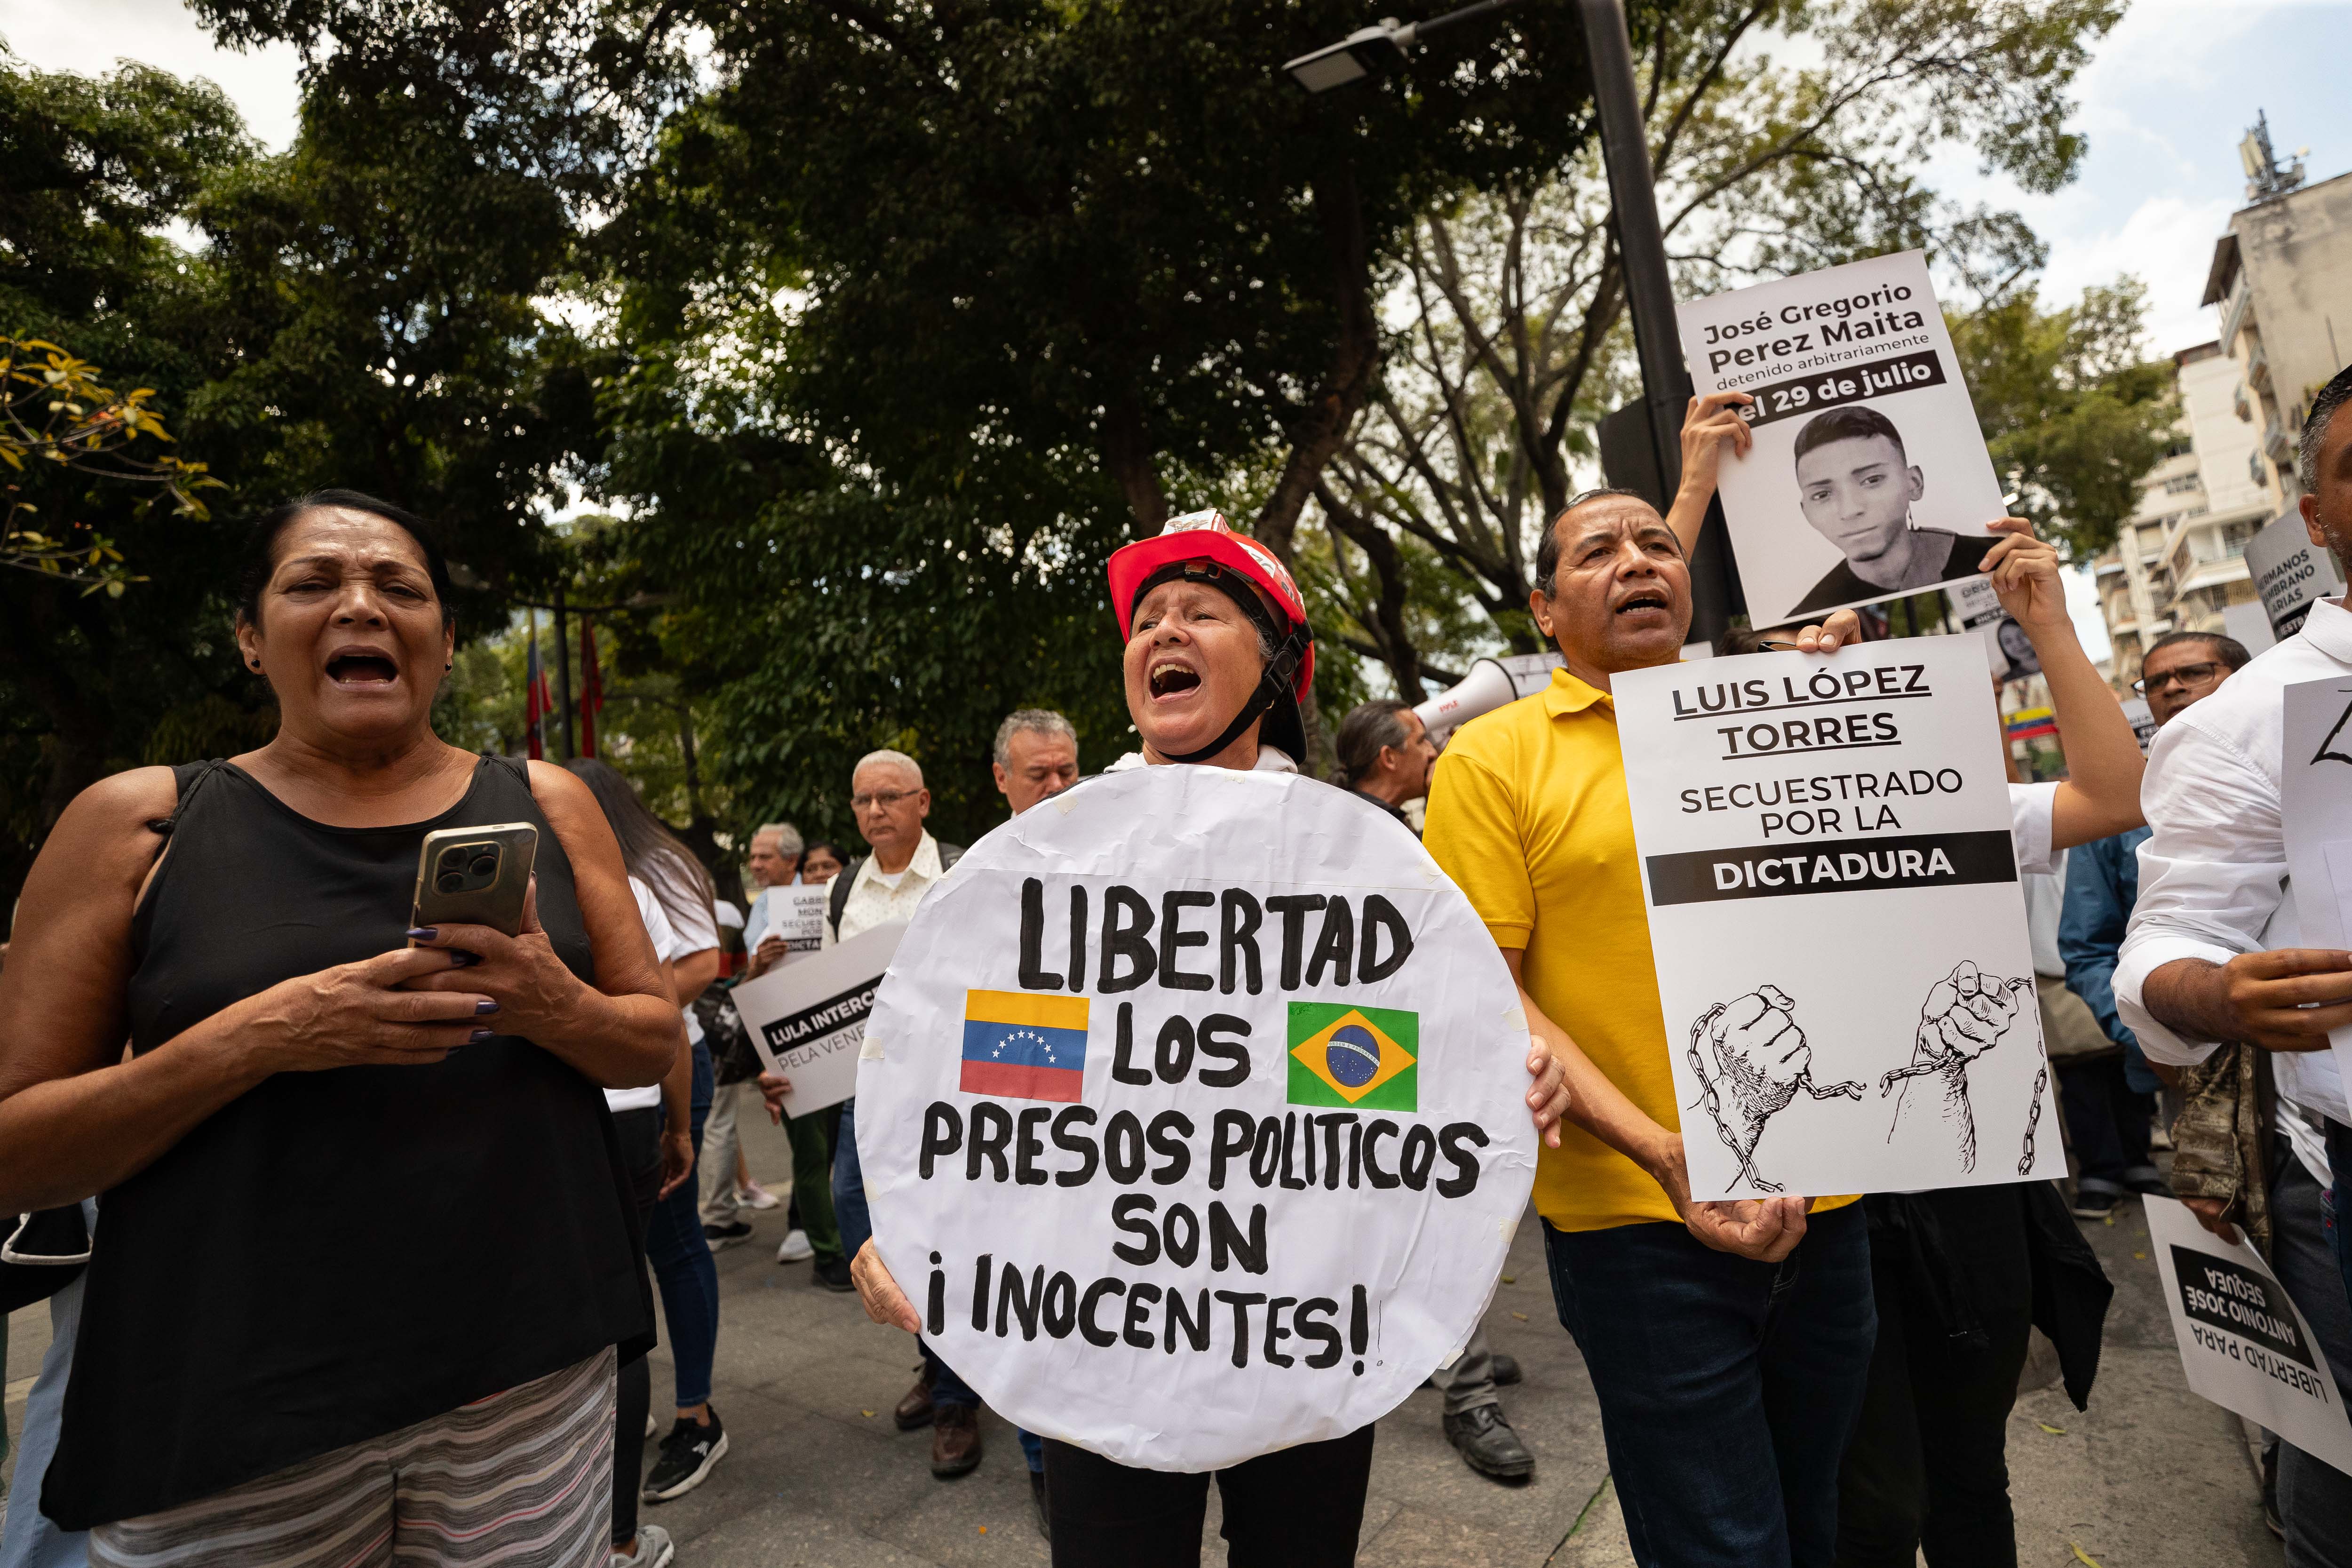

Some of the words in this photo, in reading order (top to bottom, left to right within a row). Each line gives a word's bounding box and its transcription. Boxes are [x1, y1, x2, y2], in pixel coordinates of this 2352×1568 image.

[1704, 311, 1772, 344] José
[1780, 284, 1912, 324] Gregorio
[1709, 333, 1813, 374] Perez
[1820, 310, 1924, 346] Maita
[1717, 363, 1793, 390] detenido
[1798, 334, 1930, 369] arbitrariamente
[1738, 396, 1766, 422] el
[1772, 386, 1810, 413] 29
[1818, 378, 1856, 400] de
[1861, 361, 1931, 396] julio
[2273, 587, 2303, 613] ARIAS
[1673, 680, 1769, 716] LUIS
[1783, 664, 1930, 703] LÓPEZ
[1717, 713, 1898, 754] TORRES
[1681, 768, 1963, 813] SECUESTRADO
[1761, 809, 1843, 838] POR
[1855, 805, 1901, 830] LA
[1713, 848, 1955, 890] DICTADURA
[1018, 877, 1414, 995] LIBERTAD
[770, 1019, 812, 1046] LULA
[1112, 1002, 1251, 1088] LOS
[1352, 1045, 1379, 1065] PROGRESSO
[778, 1046, 820, 1071] PELA
[919, 1101, 1194, 1187] PRESOS
[1208, 1109, 1490, 1199] POLITICOS
[1112, 1194, 1268, 1275] SON
[2185, 1285, 2228, 1318] JOSÉ
[2203, 1267, 2266, 1308] SEQUEA
[2190, 1323, 2241, 1361] PARA
[2228, 1300, 2296, 1347] ANTONIO
[2244, 1345, 2328, 1404] LIBERTAD
